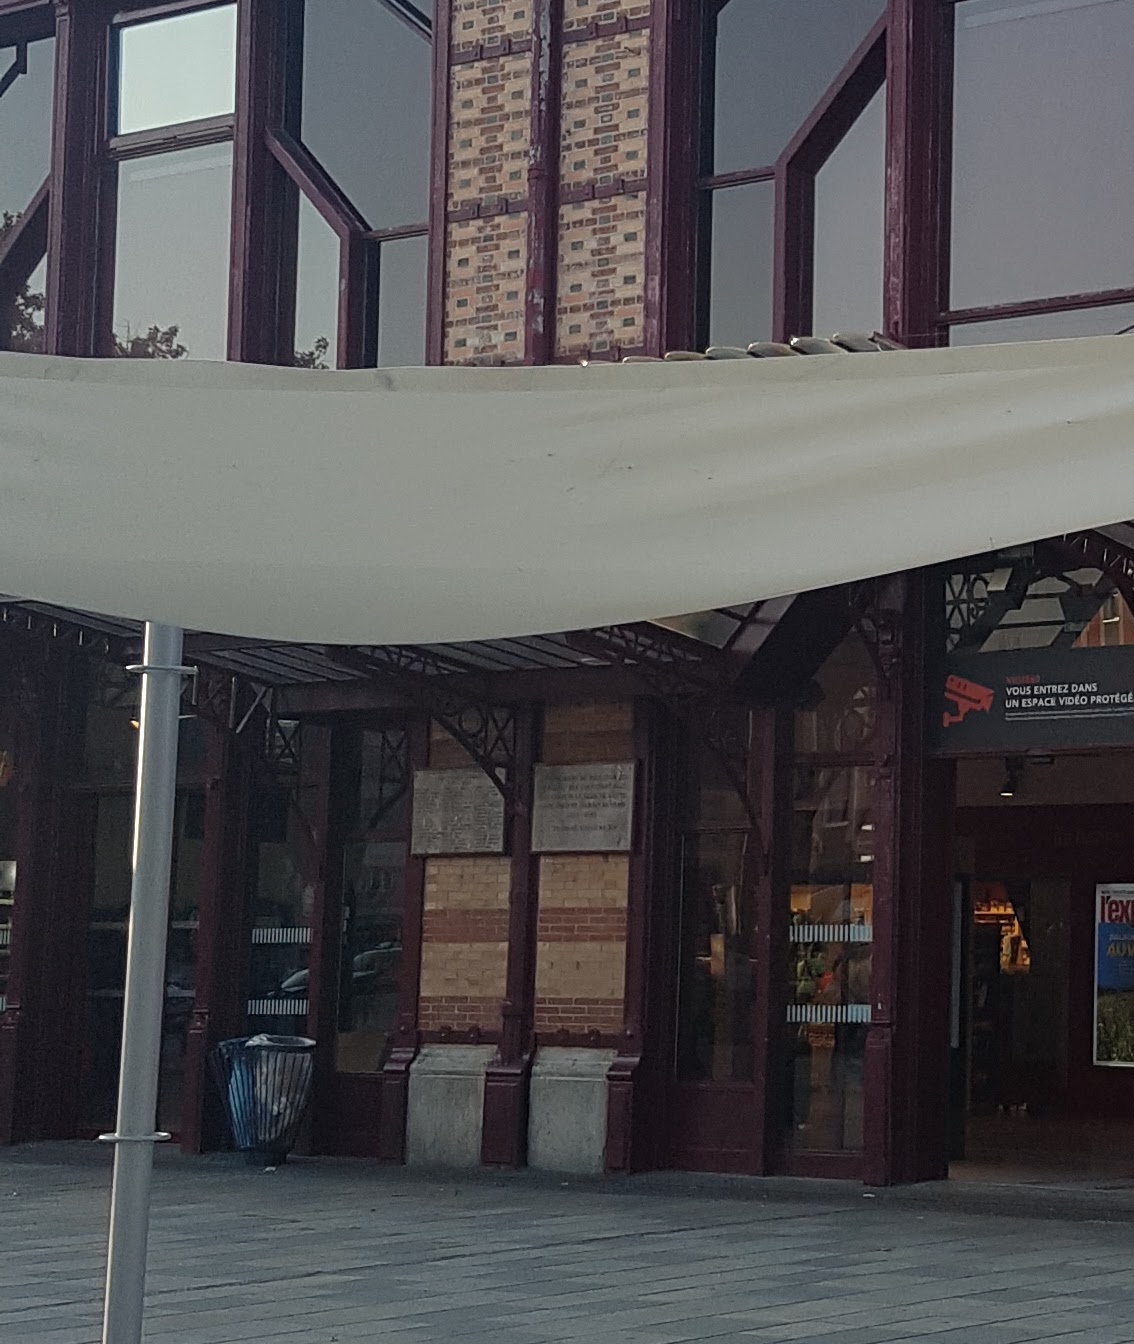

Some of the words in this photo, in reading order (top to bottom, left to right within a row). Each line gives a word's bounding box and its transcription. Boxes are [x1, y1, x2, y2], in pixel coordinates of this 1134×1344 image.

[1005, 685, 1032, 696] VOUS
[1033, 684, 1069, 695] ENTREZ
[1071, 682, 1098, 692] DANS
[1005, 699, 1019, 708] UN
[1021, 697, 1056, 707] ESPACE
[1059, 694, 1088, 705] VIDÉO
